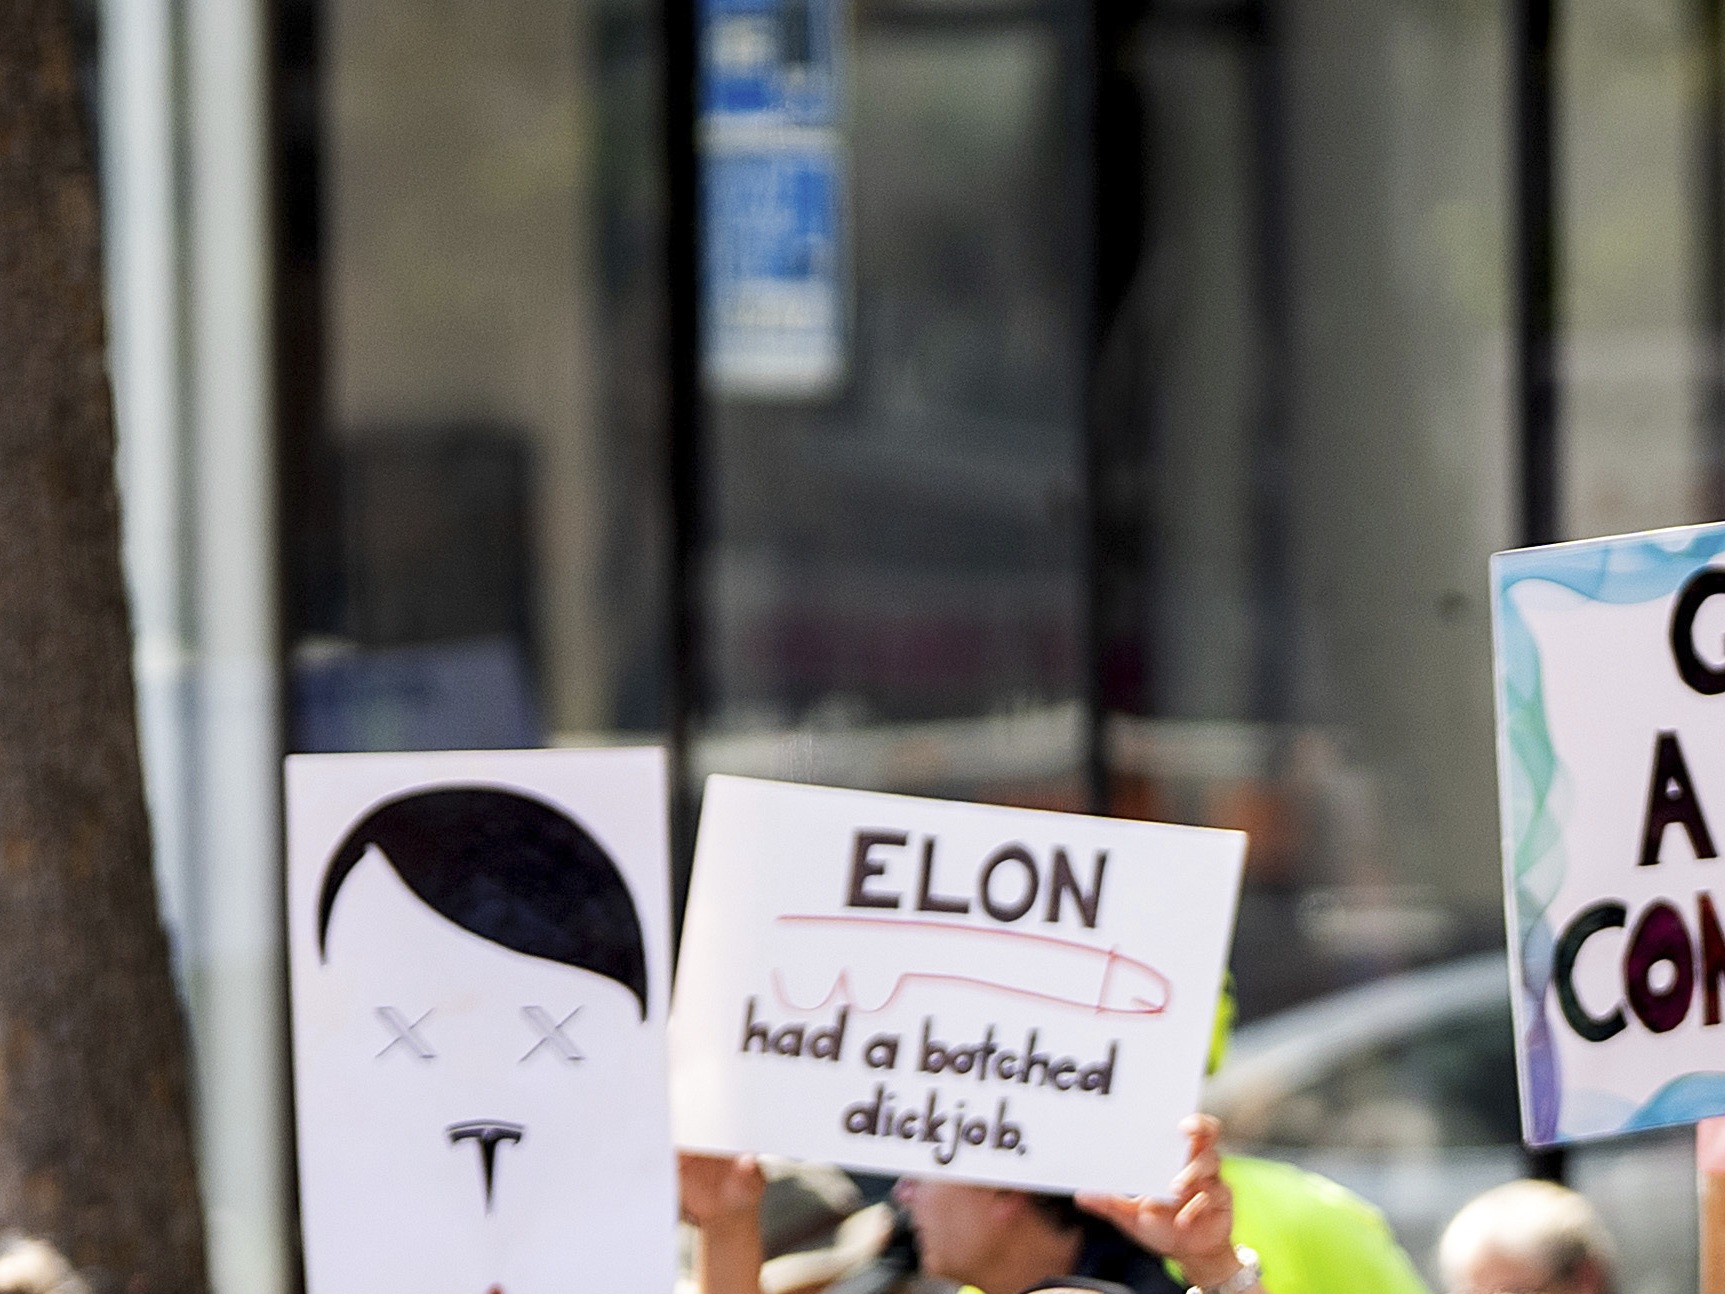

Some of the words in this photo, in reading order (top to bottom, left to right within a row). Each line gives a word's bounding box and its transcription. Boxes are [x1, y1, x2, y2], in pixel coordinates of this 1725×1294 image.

[1638, 729, 1717, 866] A
[844, 829, 1112, 928] ELON
[739, 997, 851, 1061] had
[864, 1033, 899, 1069] a
[920, 1018, 1119, 1095] botched
[844, 1084, 1026, 1165] dickjob.
